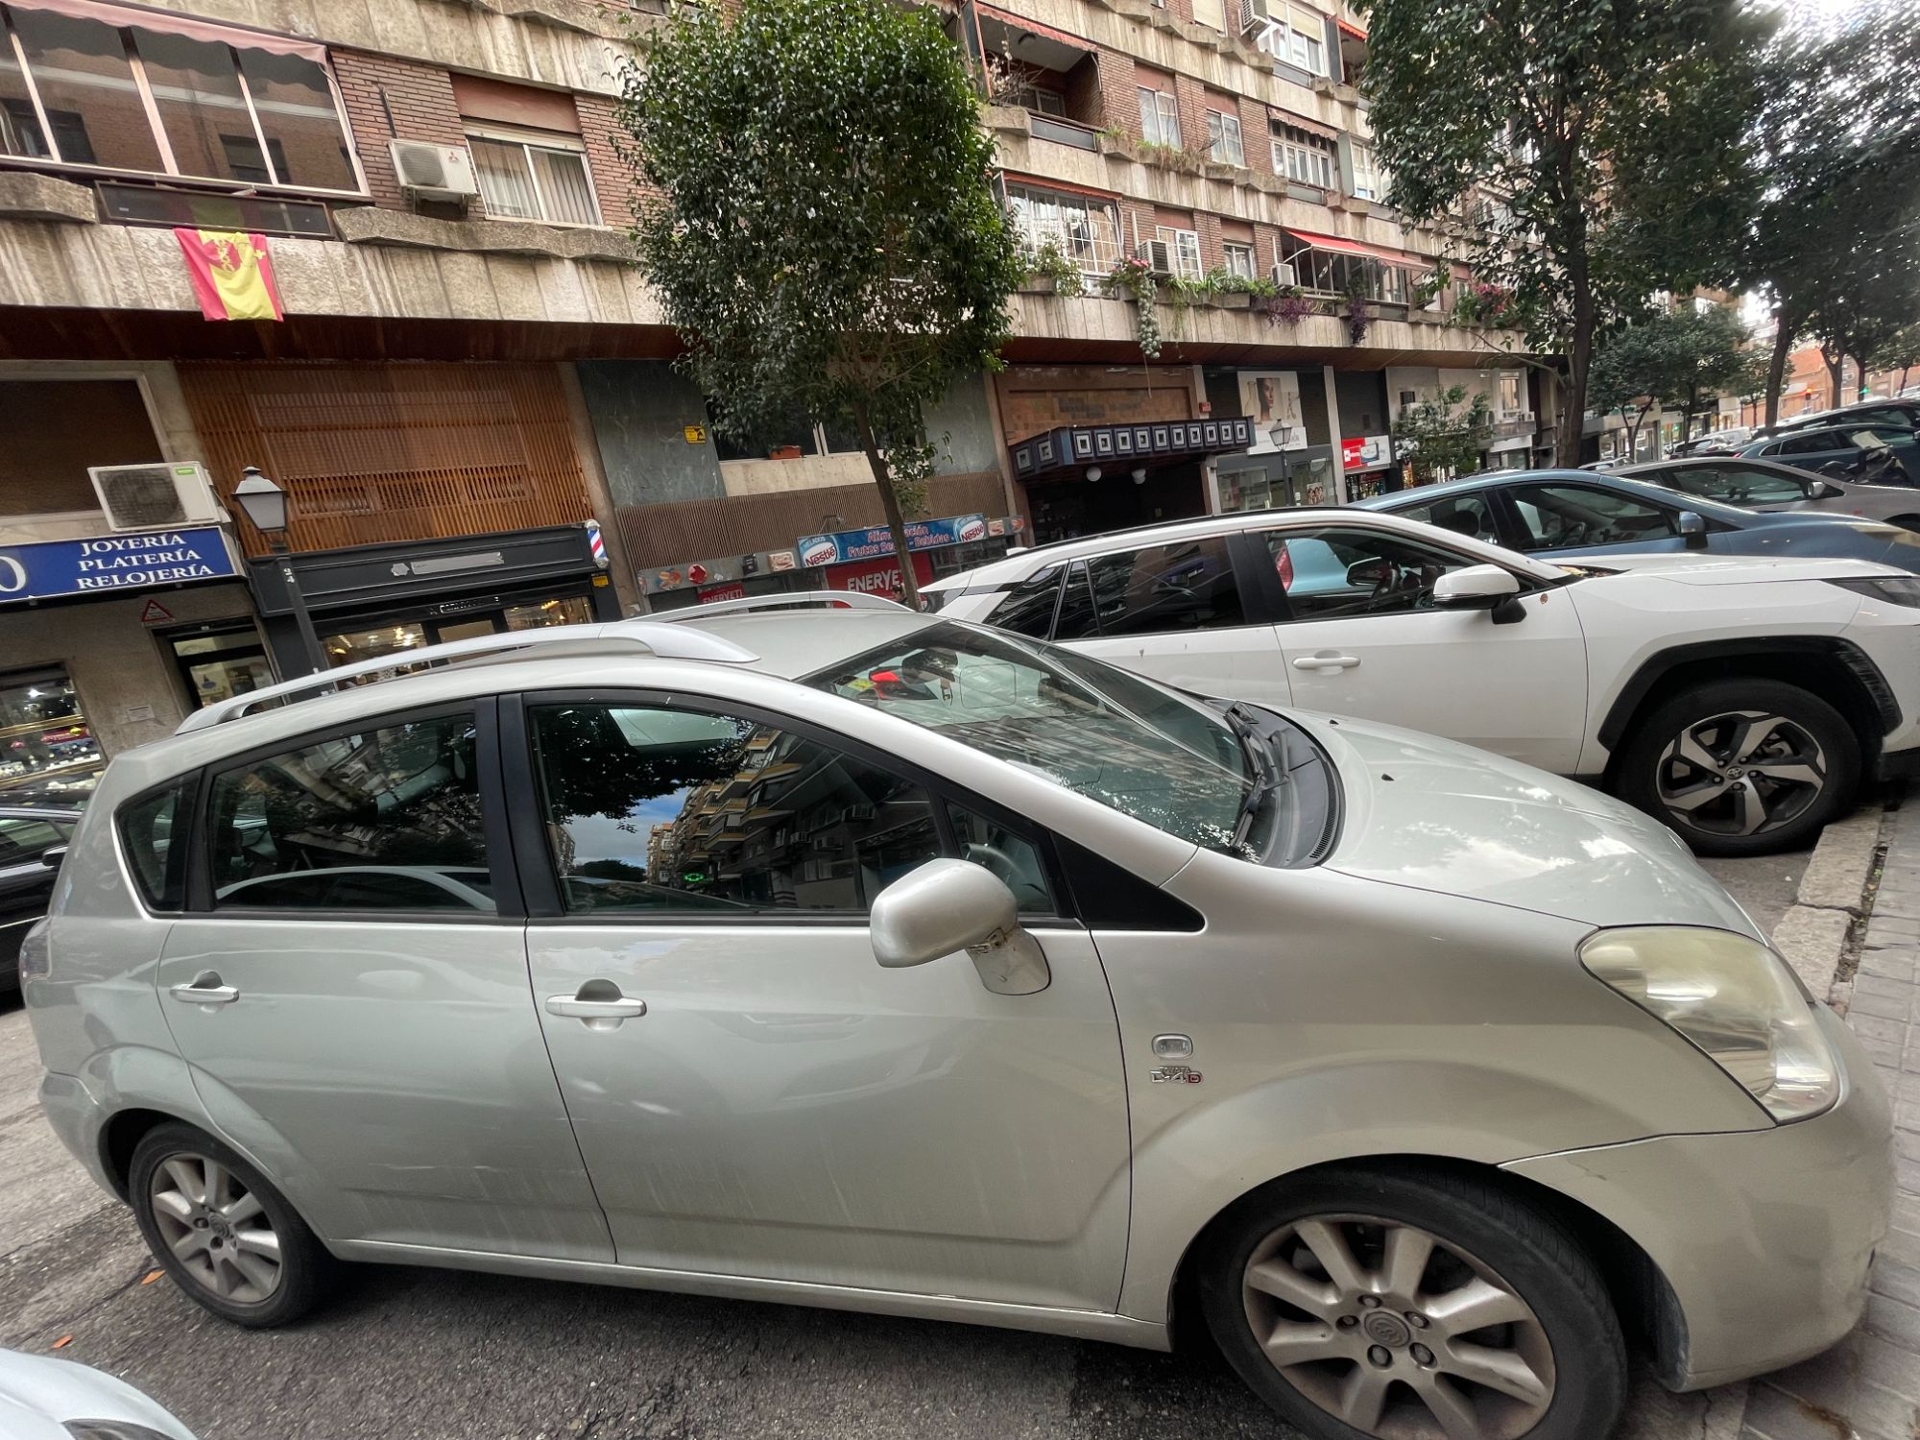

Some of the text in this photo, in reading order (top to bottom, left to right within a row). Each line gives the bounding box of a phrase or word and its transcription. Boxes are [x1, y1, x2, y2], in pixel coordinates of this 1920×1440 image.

[868, 526, 928, 542] Alimación
[961, 524, 983, 542] Nestlé
[80, 534, 187, 557] JOYERÍA
[805, 546, 836, 566] Nestlé
[848, 544, 880, 557] Frutos
[914, 534, 950, 547] Bebidas
[78, 549, 202, 571] PLATERÍA
[76, 564, 215, 589] RELOJERÍA
[847, 569, 903, 592] ENERYE
